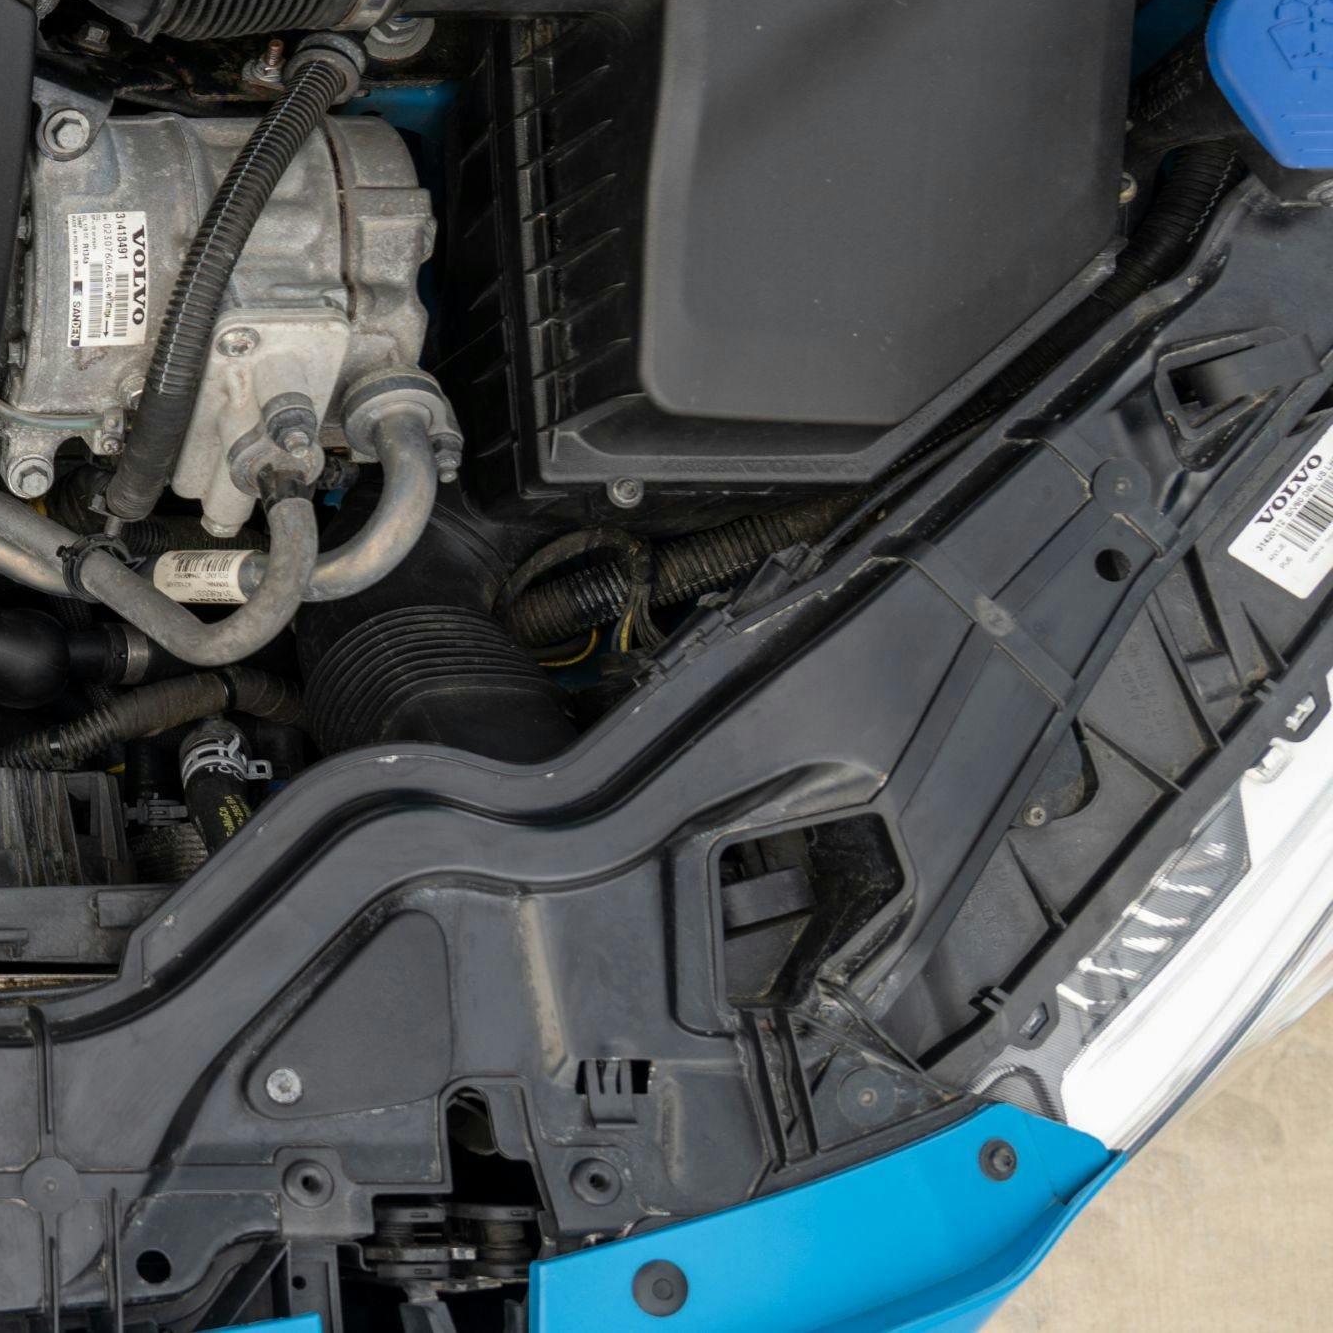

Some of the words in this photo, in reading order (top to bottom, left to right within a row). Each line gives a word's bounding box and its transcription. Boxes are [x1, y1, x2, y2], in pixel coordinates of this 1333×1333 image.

[132, 225, 146, 325] VOLVO
[71, 301, 80, 341] SANDEN
[1255, 454, 1322, 525] VOLVO
